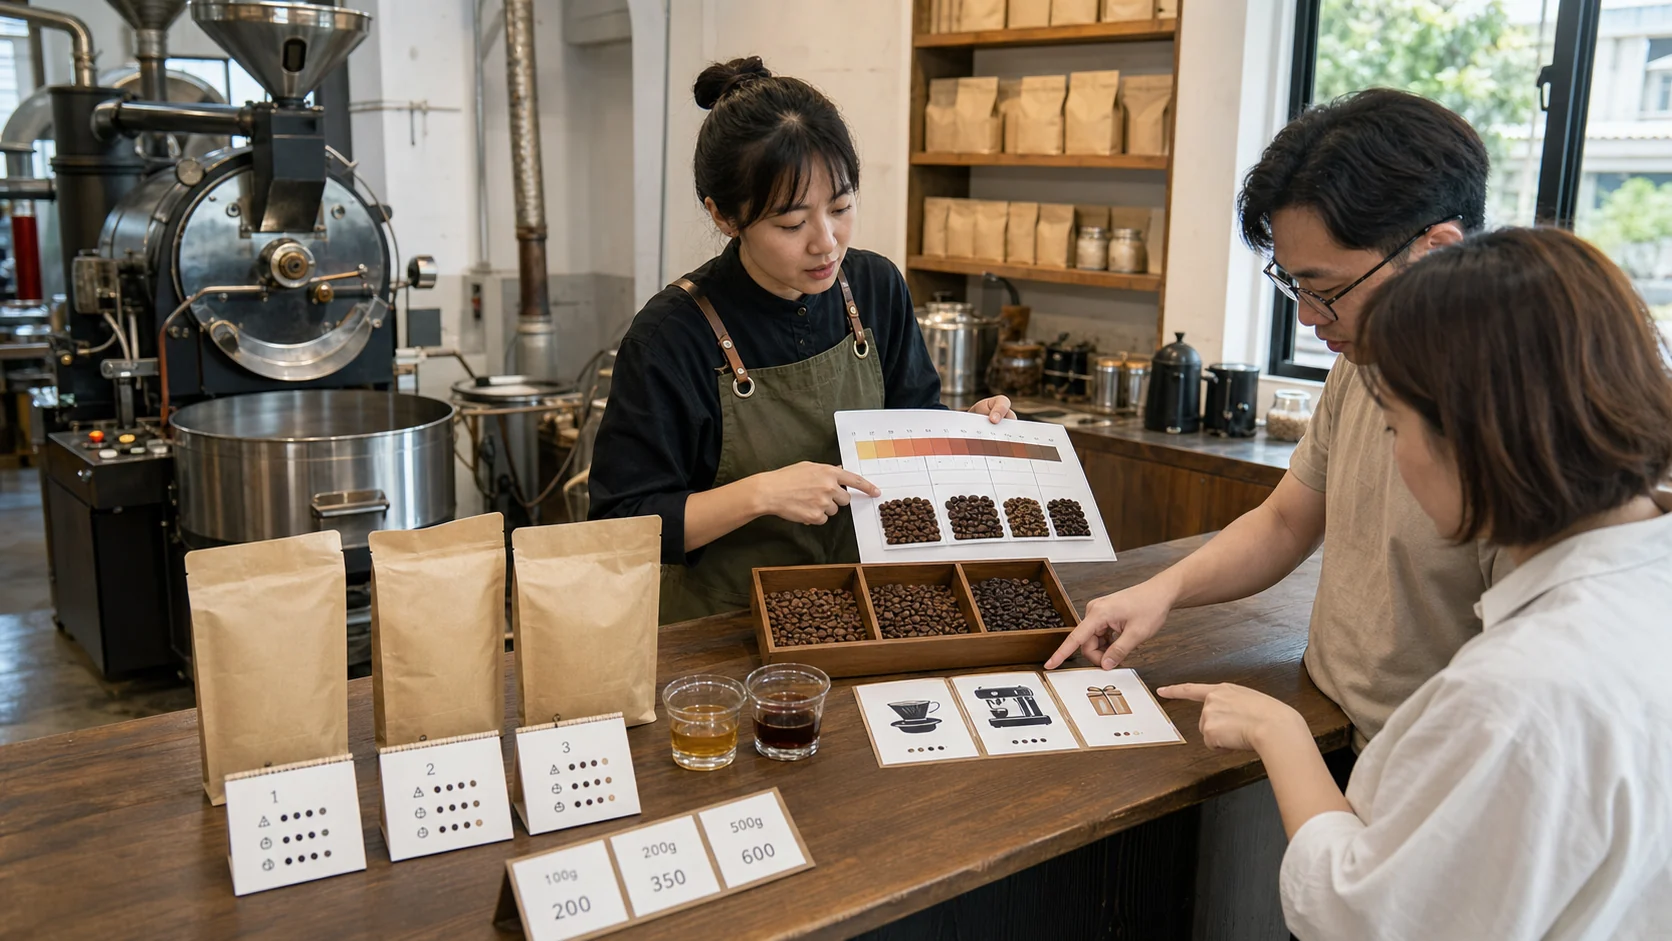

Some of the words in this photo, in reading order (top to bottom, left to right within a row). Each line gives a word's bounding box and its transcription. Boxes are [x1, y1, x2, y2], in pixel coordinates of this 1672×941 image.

[562, 741, 571, 754] 3
[426, 763, 436, 776] 2
[270, 790, 278, 804] 1
[730, 816, 764, 833] 500g
[642, 841, 677, 858] 200g
[741, 843, 776, 865] 600
[545, 869, 578, 885] 100g
[650, 869, 687, 892] 350
[552, 896, 591, 920] 200
